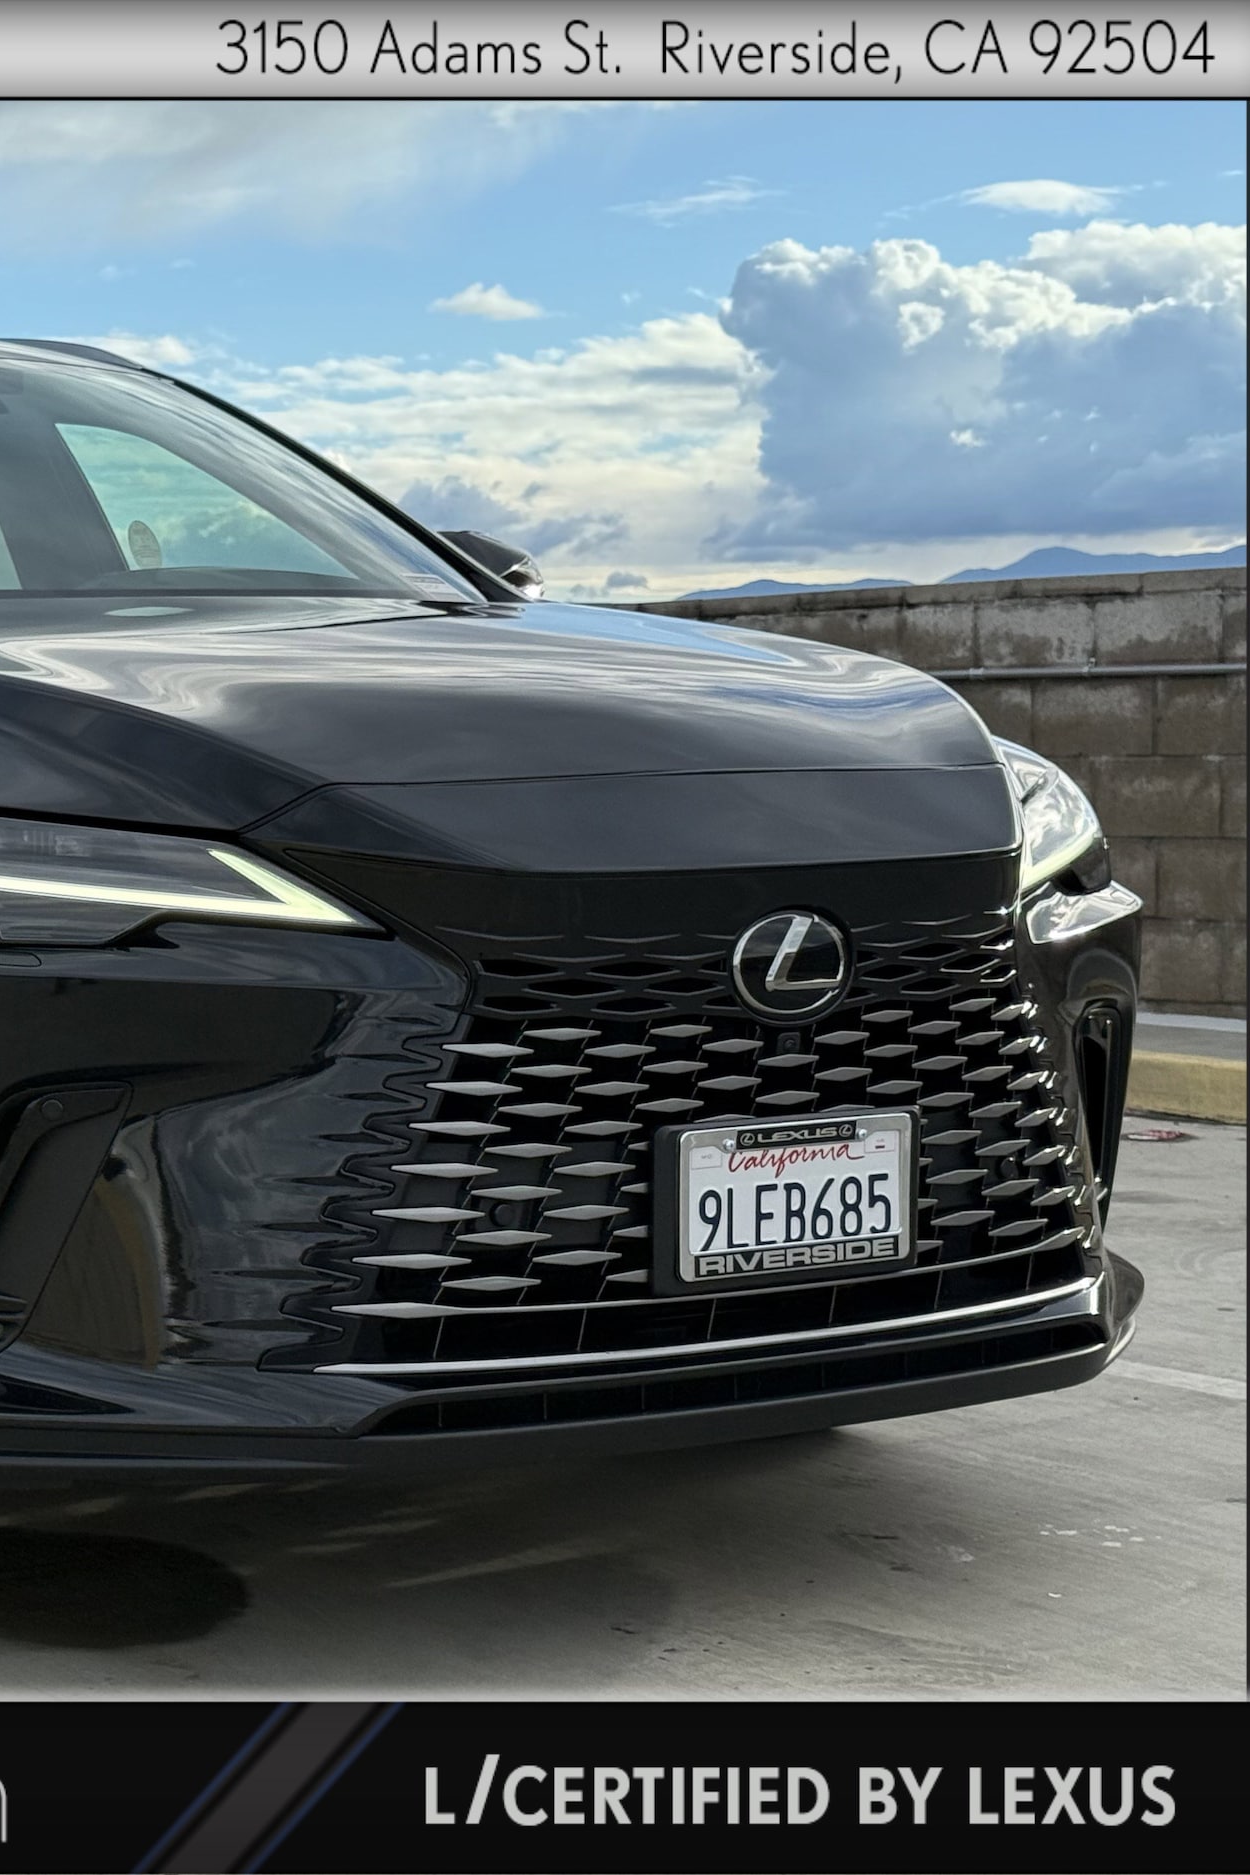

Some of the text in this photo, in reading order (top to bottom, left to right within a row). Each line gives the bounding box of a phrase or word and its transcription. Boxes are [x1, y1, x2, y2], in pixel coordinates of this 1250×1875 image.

[757, 1127, 838, 1144] LEXUS
[727, 1143, 865, 1178] California
[698, 1172, 892, 1252] 9LEB685
[699, 1238, 895, 1277] RIVERSIDE
